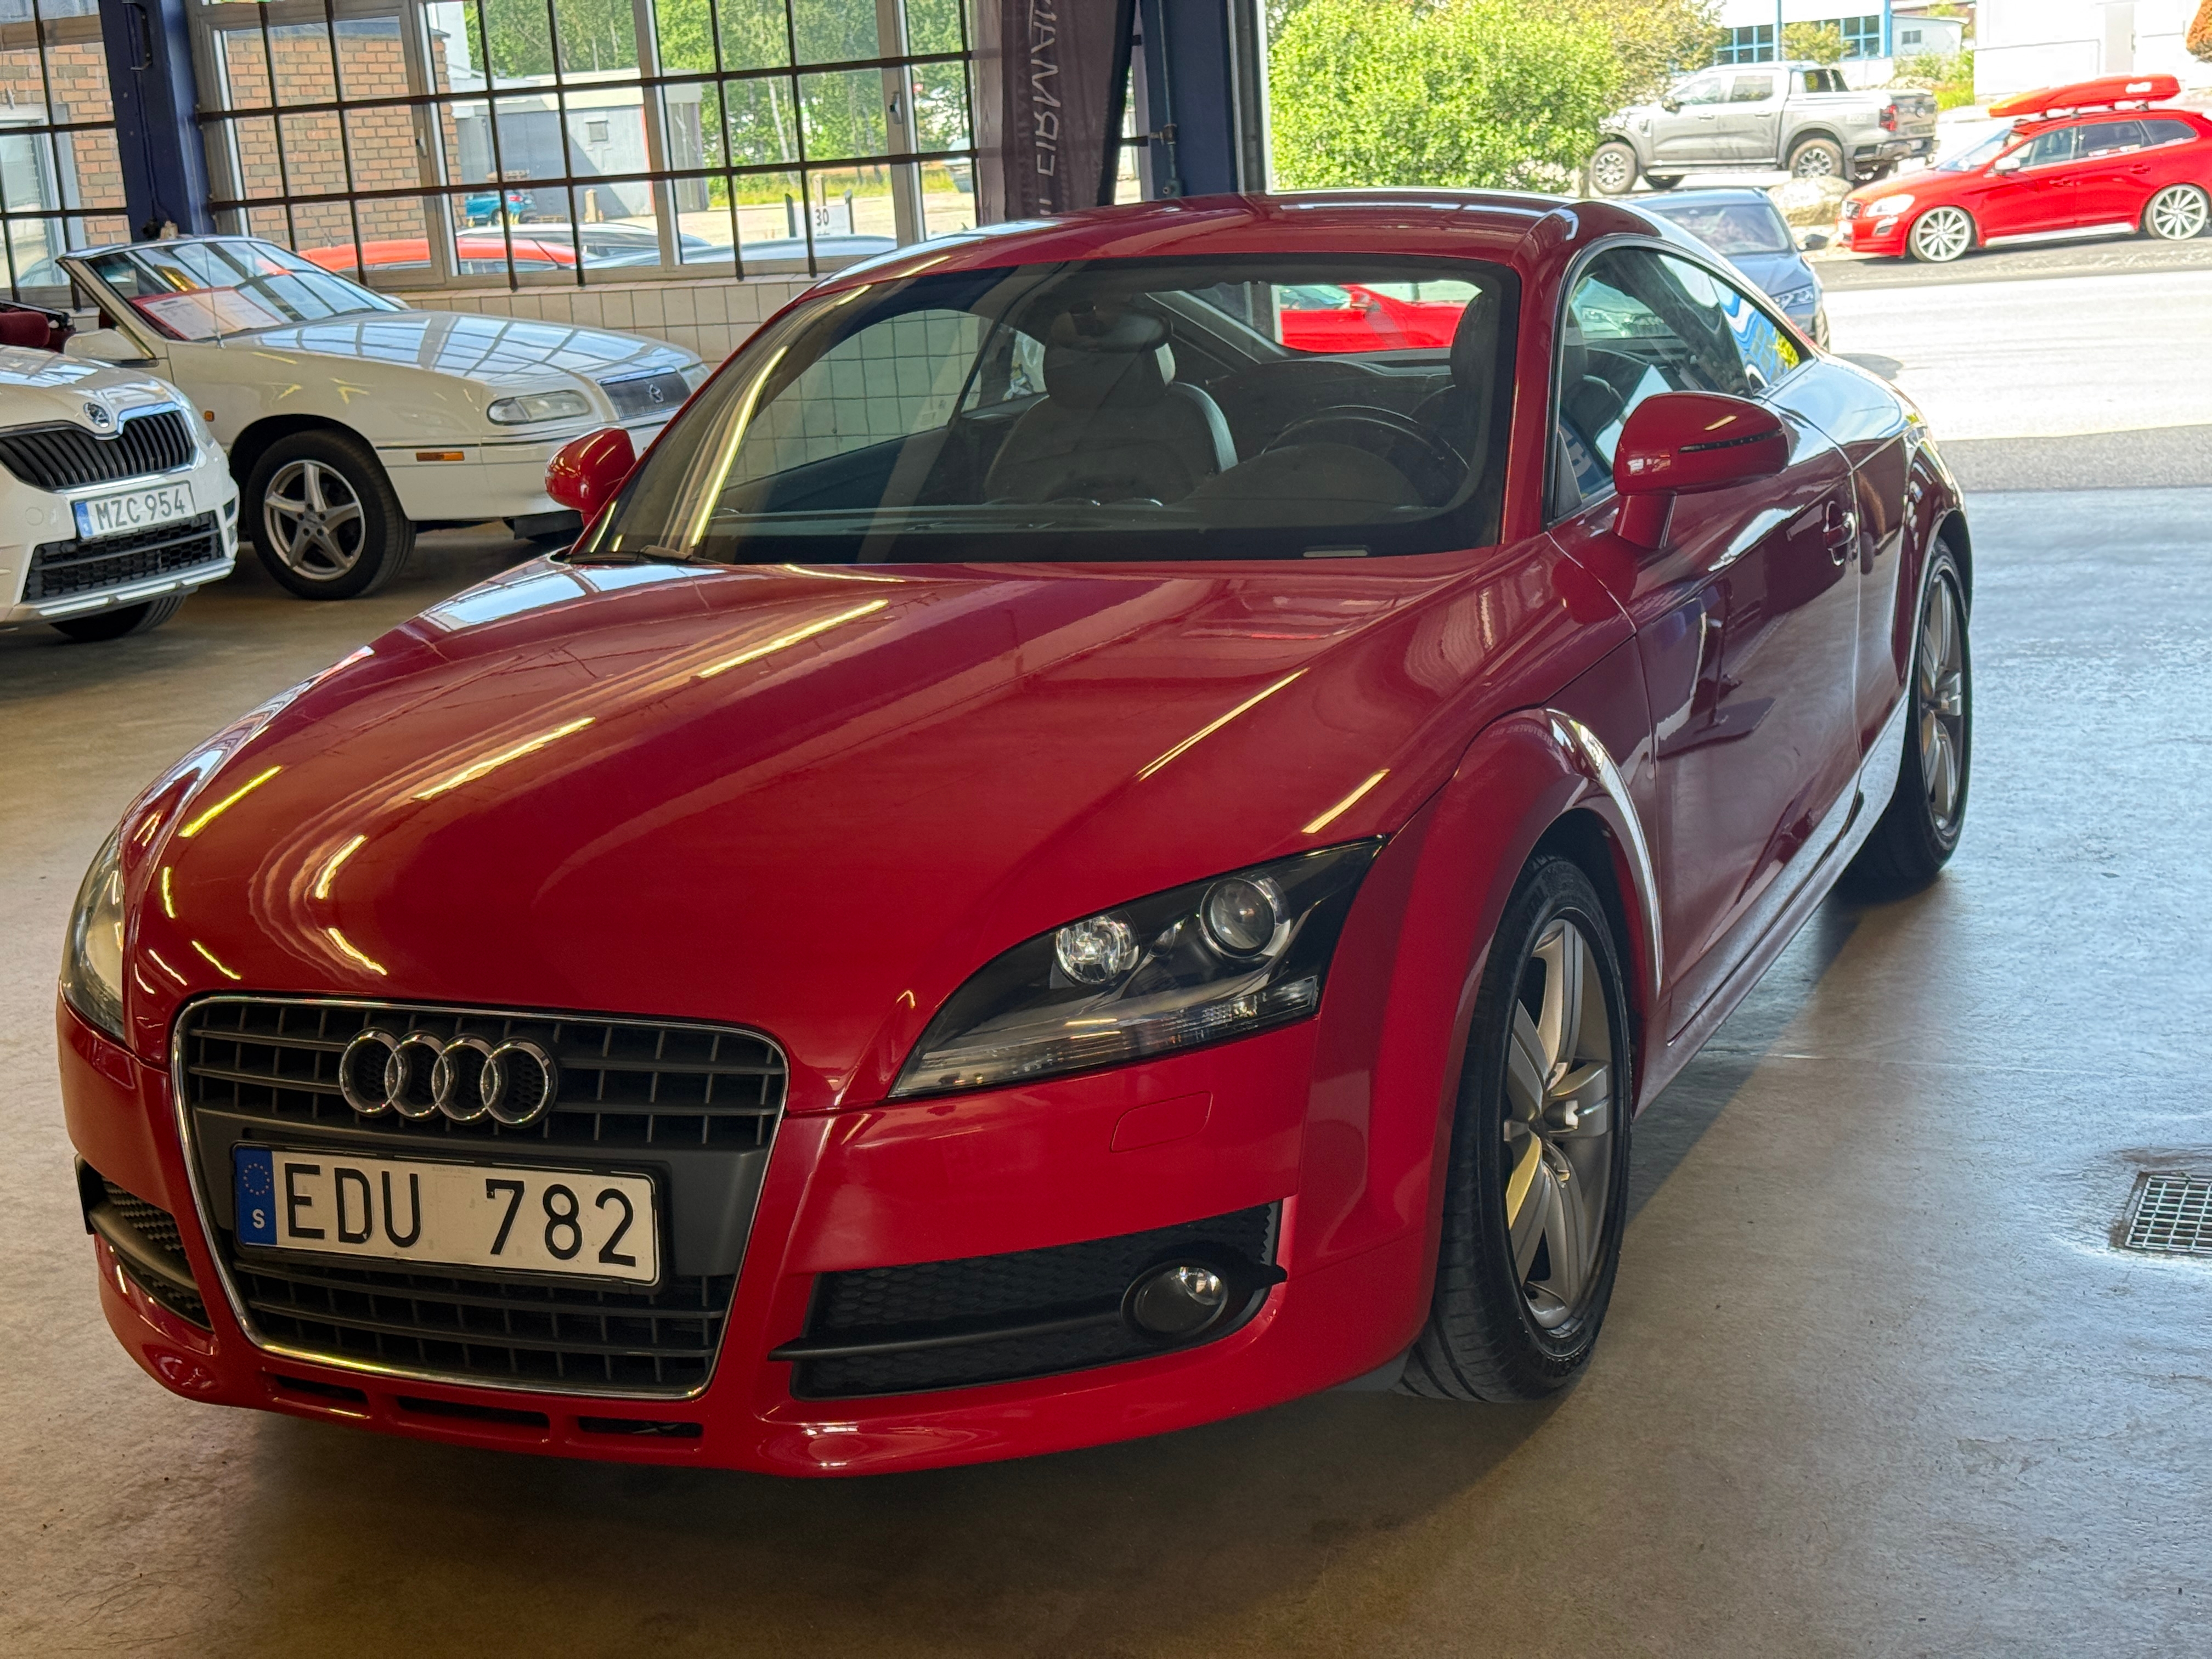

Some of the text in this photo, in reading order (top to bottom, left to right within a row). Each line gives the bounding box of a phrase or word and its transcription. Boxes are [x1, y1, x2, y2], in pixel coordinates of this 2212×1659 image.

[815, 208, 830, 227] 30
[95, 488, 185, 531] MZC 954
[253, 1209, 265, 1229] S
[284, 1163, 637, 1267] EDU 782
